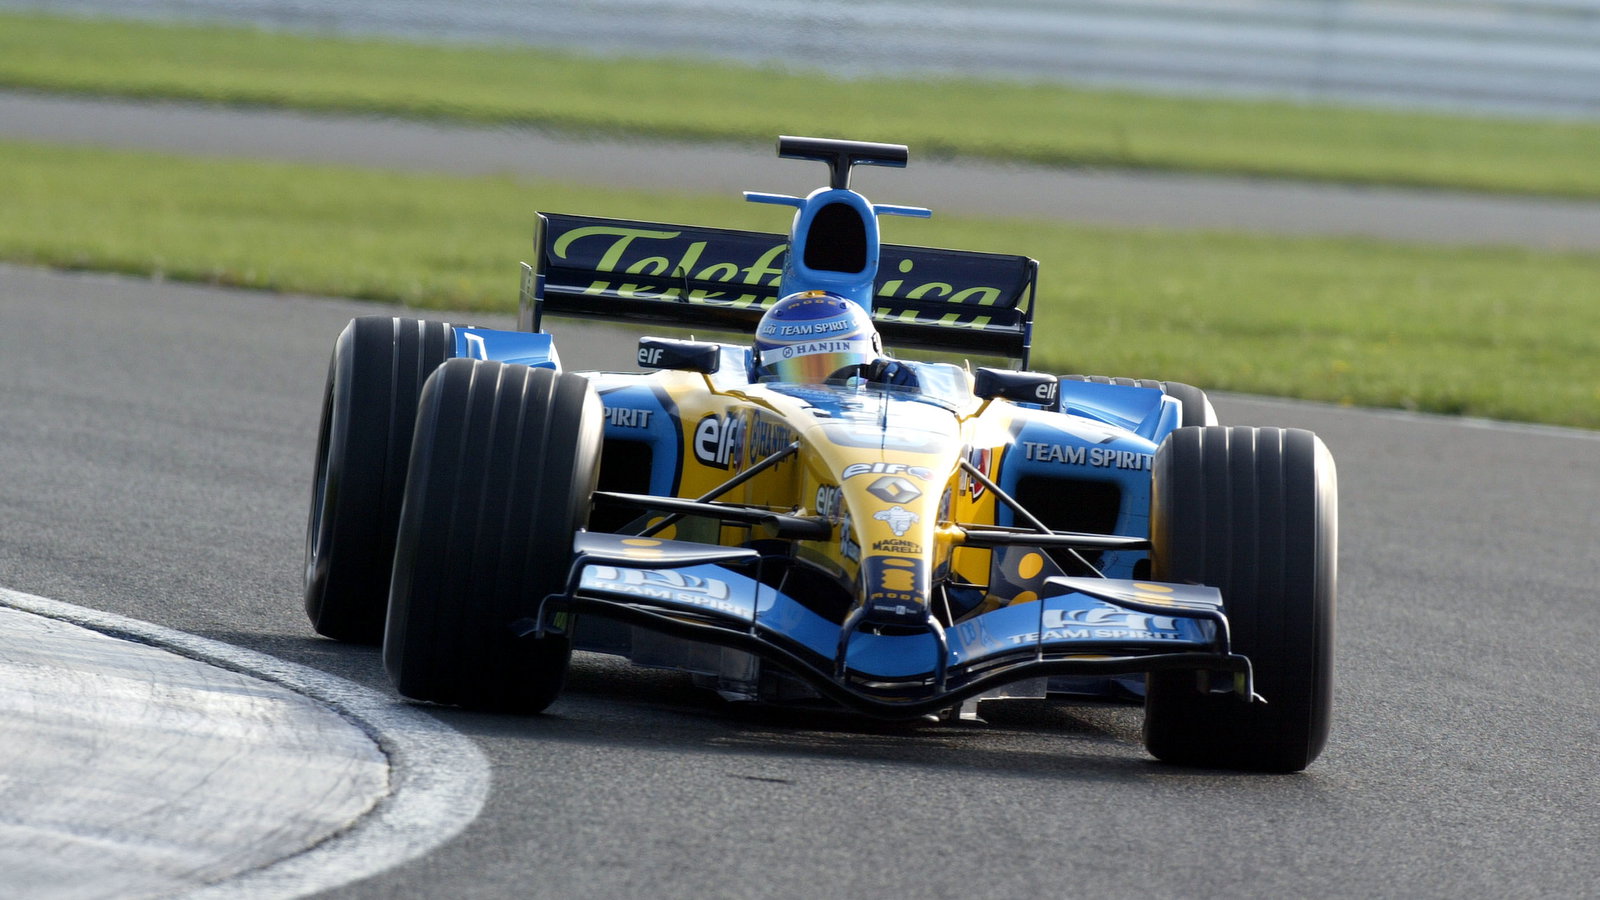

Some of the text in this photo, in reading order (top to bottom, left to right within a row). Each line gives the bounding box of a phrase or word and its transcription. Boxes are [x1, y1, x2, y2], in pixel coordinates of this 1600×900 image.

[553, 225, 1001, 329] Telefica
[780, 325, 813, 336] TEAM
[815, 320, 848, 333] SPIRIT
[638, 348, 664, 365] elf
[797, 342, 850, 354] HANJIN
[1035, 383, 1057, 399] elf
[603, 407, 653, 428] PIRIT
[694, 416, 739, 465] elf
[1023, 442, 1154, 471] TEAM SPIRIT
[842, 462, 907, 480] elf
[1007, 629, 1183, 644] TEAM SPIRIT
